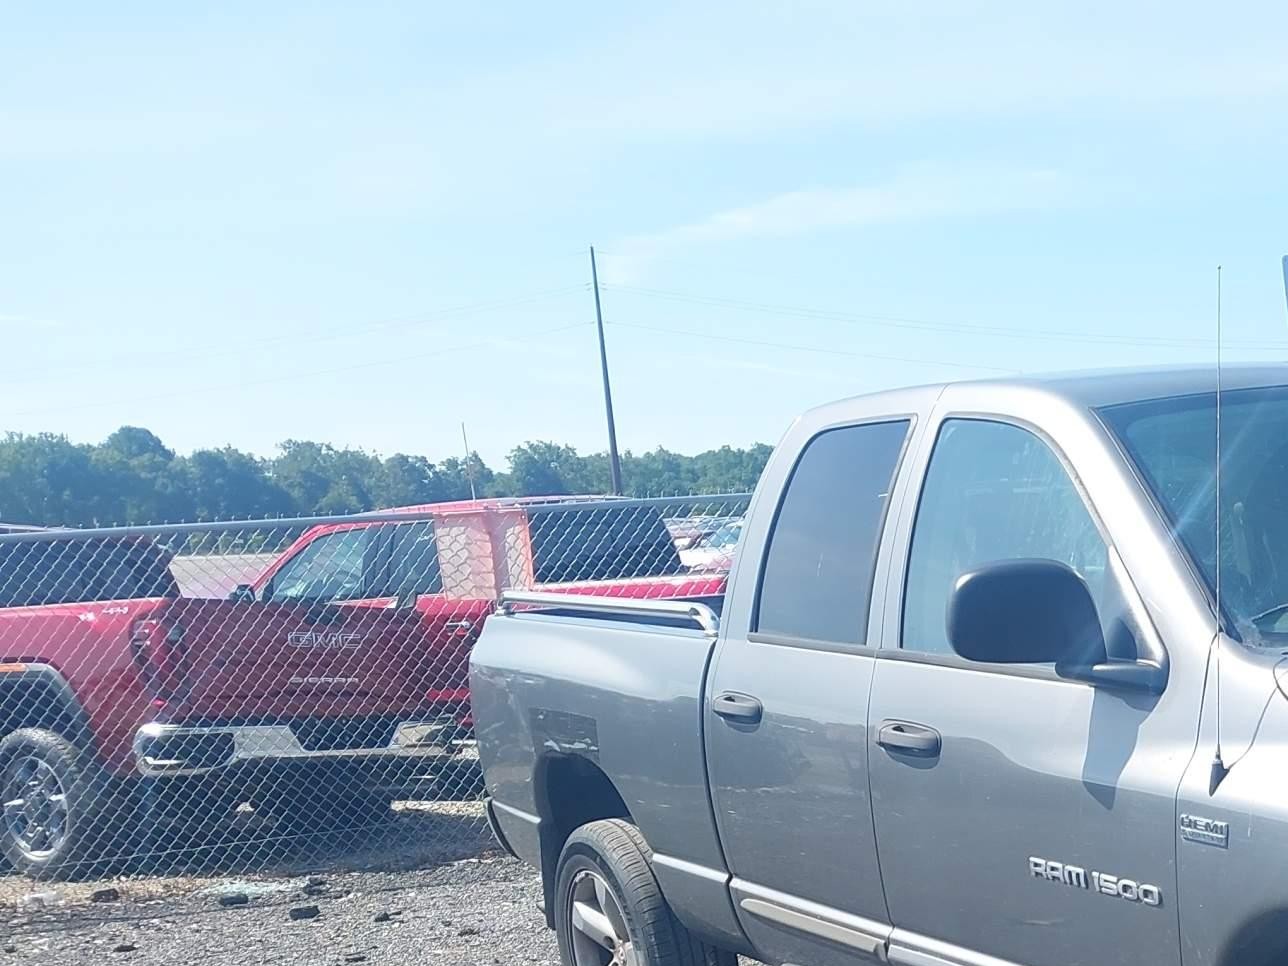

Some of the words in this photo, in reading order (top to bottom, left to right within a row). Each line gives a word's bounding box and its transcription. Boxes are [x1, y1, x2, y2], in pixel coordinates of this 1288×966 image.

[287, 631, 361, 649] GMC
[289, 676, 360, 684] SIERRA
[1180, 815, 1224, 835] HEMI
[1028, 856, 1088, 889] RAM
[1091, 870, 1163, 906] 1500
